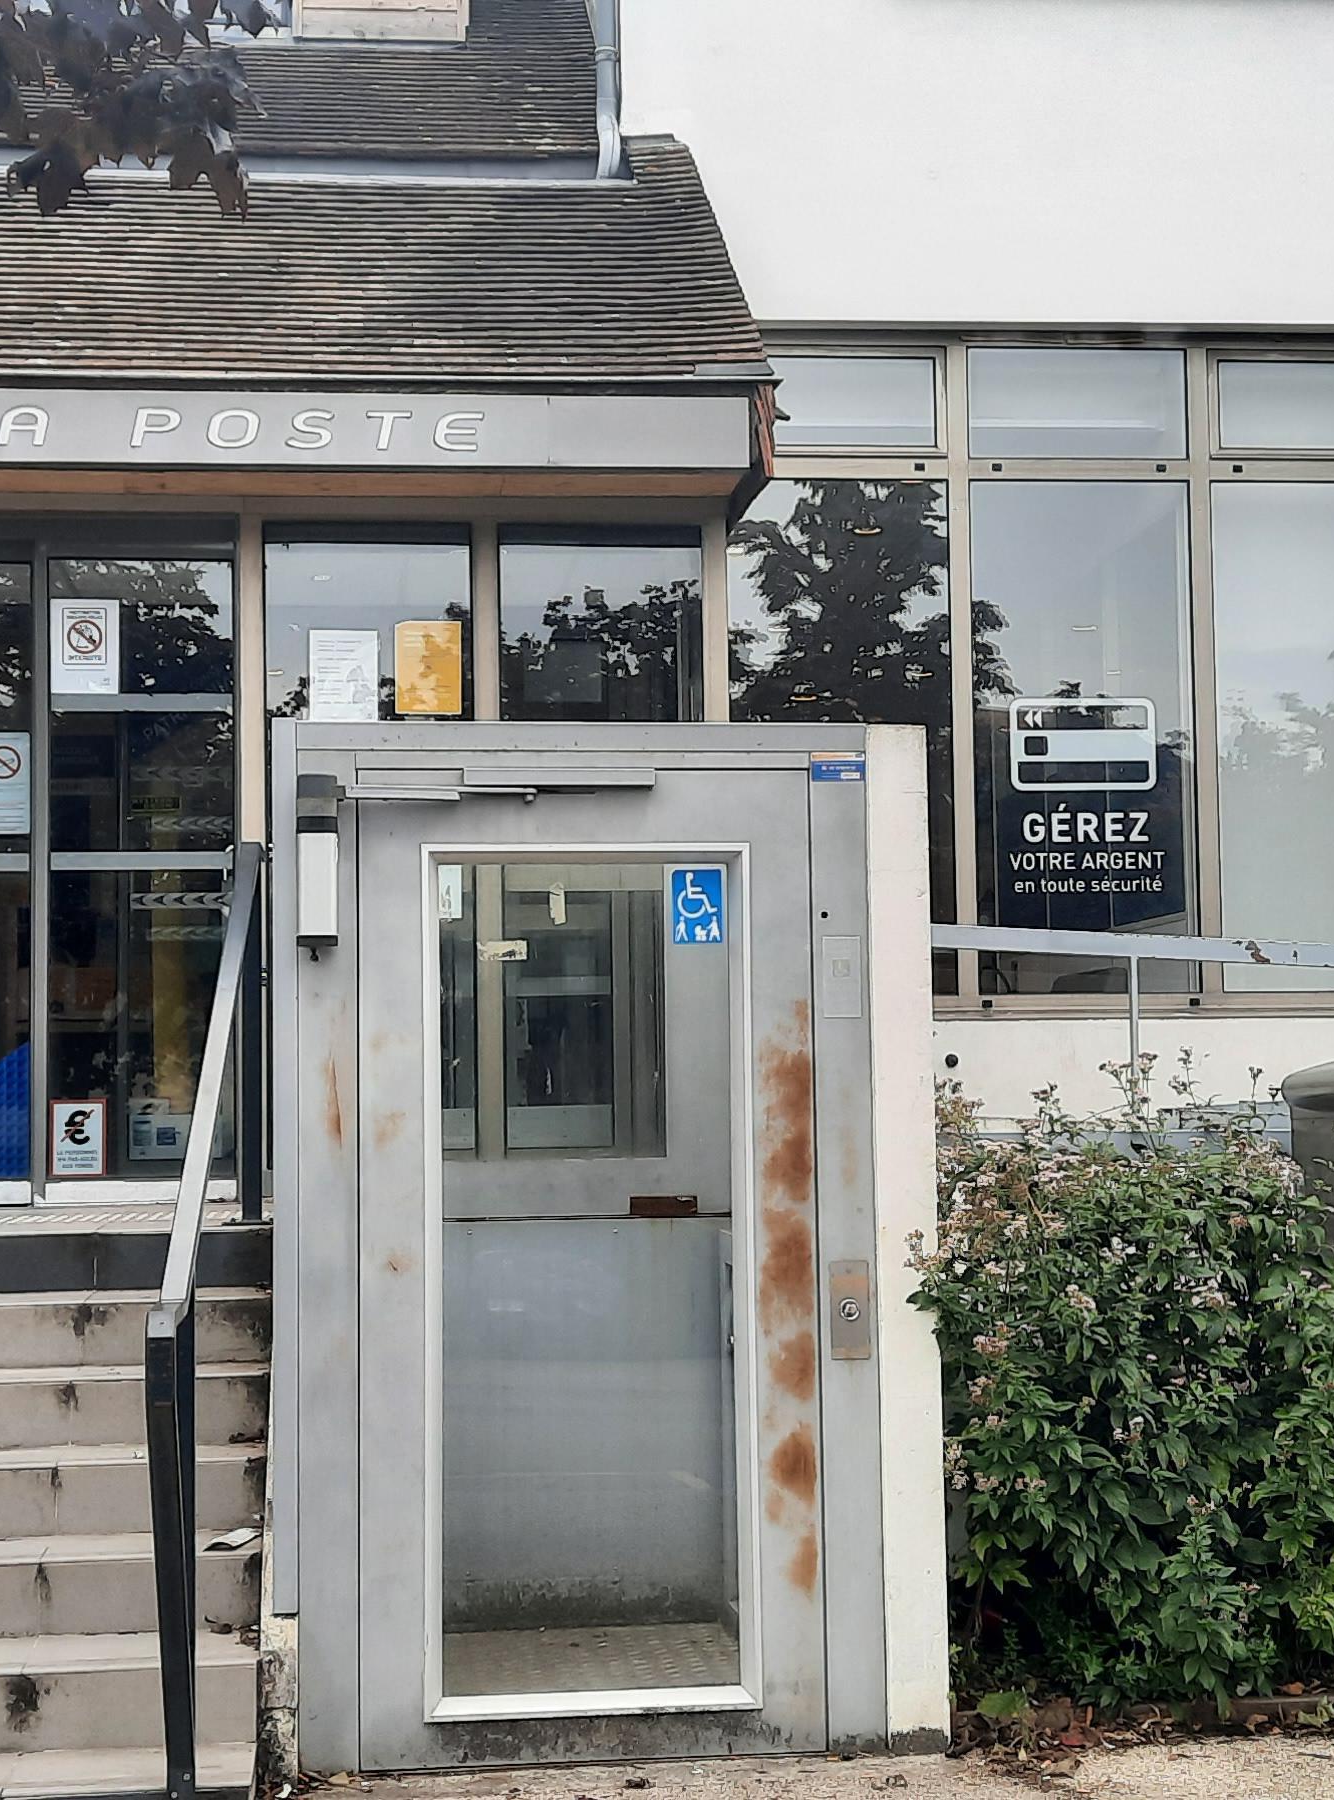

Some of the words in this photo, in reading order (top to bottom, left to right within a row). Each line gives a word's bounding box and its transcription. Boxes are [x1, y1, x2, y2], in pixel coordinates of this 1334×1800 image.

[129, 406, 486, 451] POSTE
[1022, 803, 1150, 843] GÉREZ
[1010, 852, 1076, 871] VOTRE
[1081, 851, 1165, 870] ARGENT
[1014, 880, 1035, 893] en
[1041, 878, 1086, 893] toute
[1090, 874, 1163, 893] sécurité
